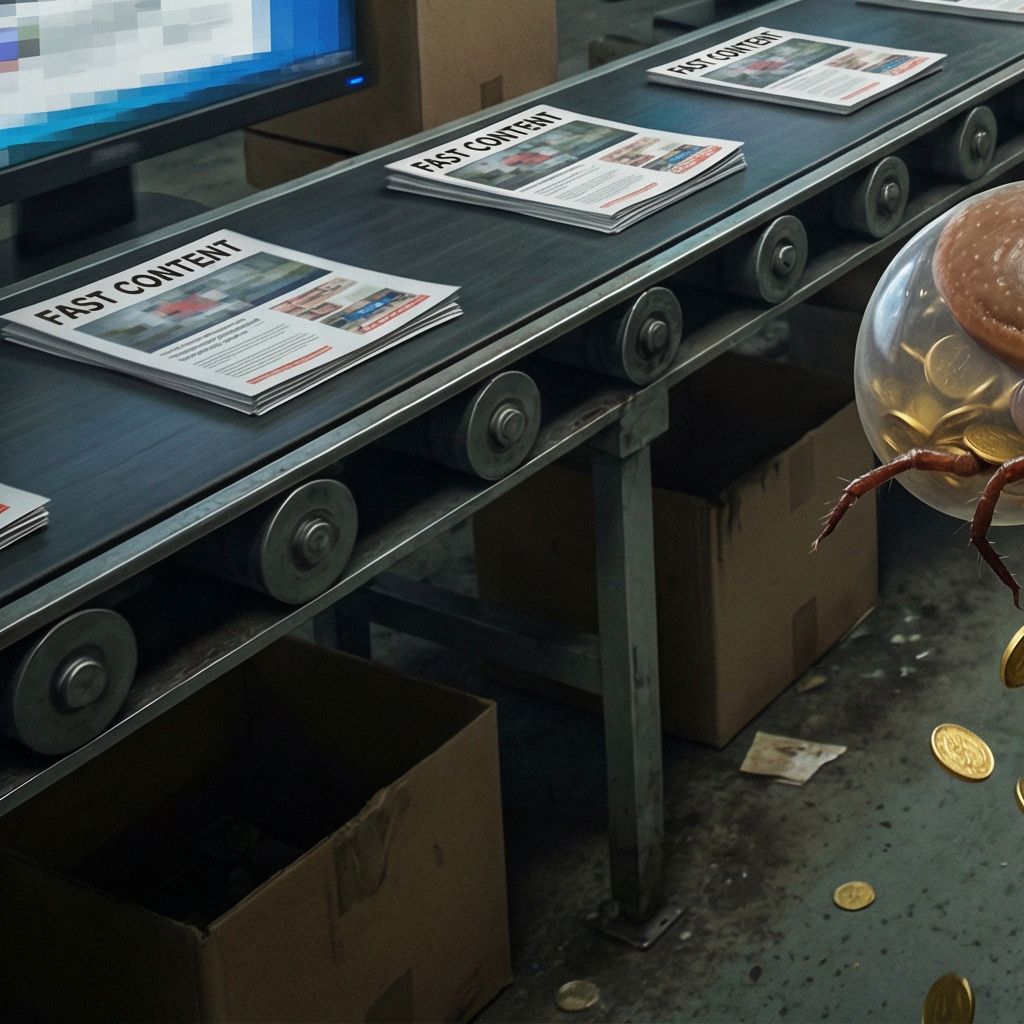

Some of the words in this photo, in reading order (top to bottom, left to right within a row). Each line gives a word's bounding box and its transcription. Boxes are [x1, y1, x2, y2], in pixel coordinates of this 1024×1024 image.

[667, 58, 717, 75] FAST
[410, 148, 470, 172] FAST
[463, 111, 563, 152] CONTENT
[34, 290, 118, 326] FAST
[114, 239, 242, 295] CONTENT
